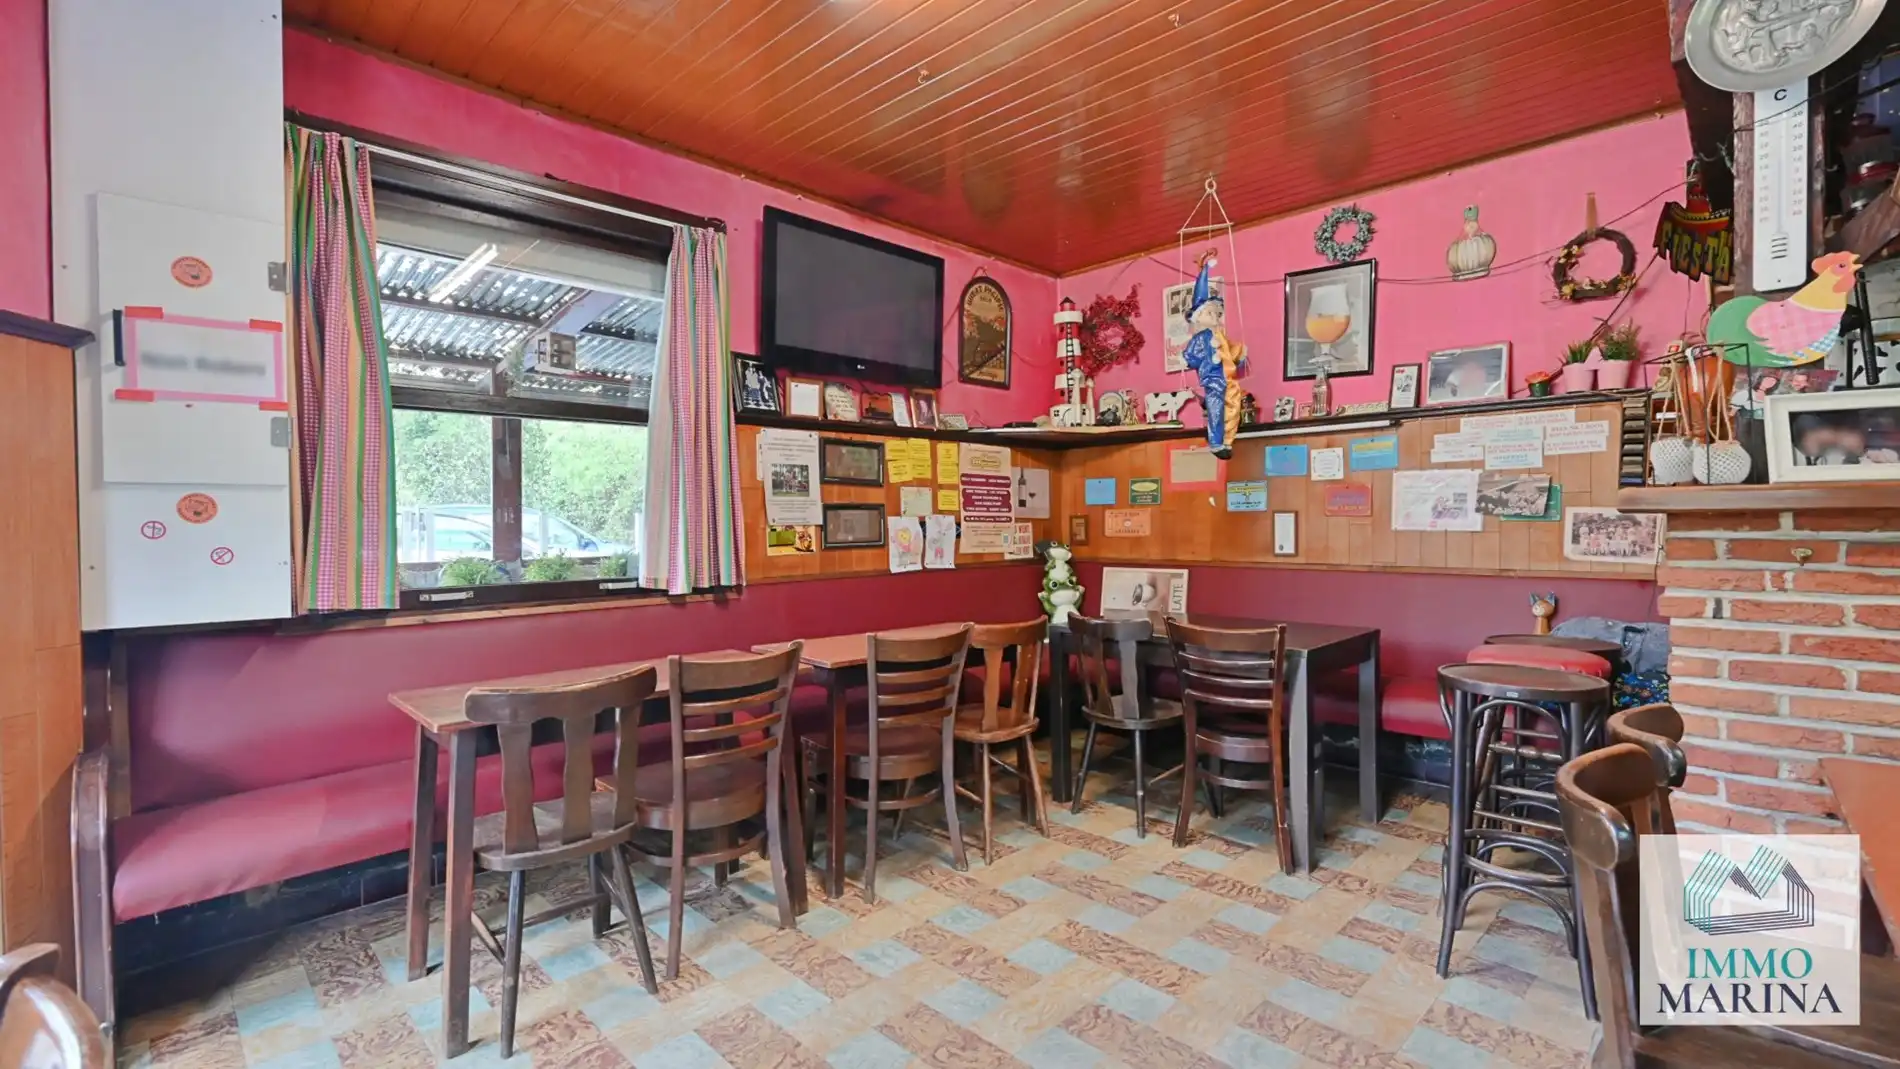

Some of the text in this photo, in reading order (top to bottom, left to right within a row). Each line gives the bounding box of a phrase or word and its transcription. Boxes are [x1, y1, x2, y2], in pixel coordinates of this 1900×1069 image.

[1773, 88, 1788, 101] C
[1661, 221, 1730, 281] FIESTA
[1171, 583, 1184, 611] LATTE
